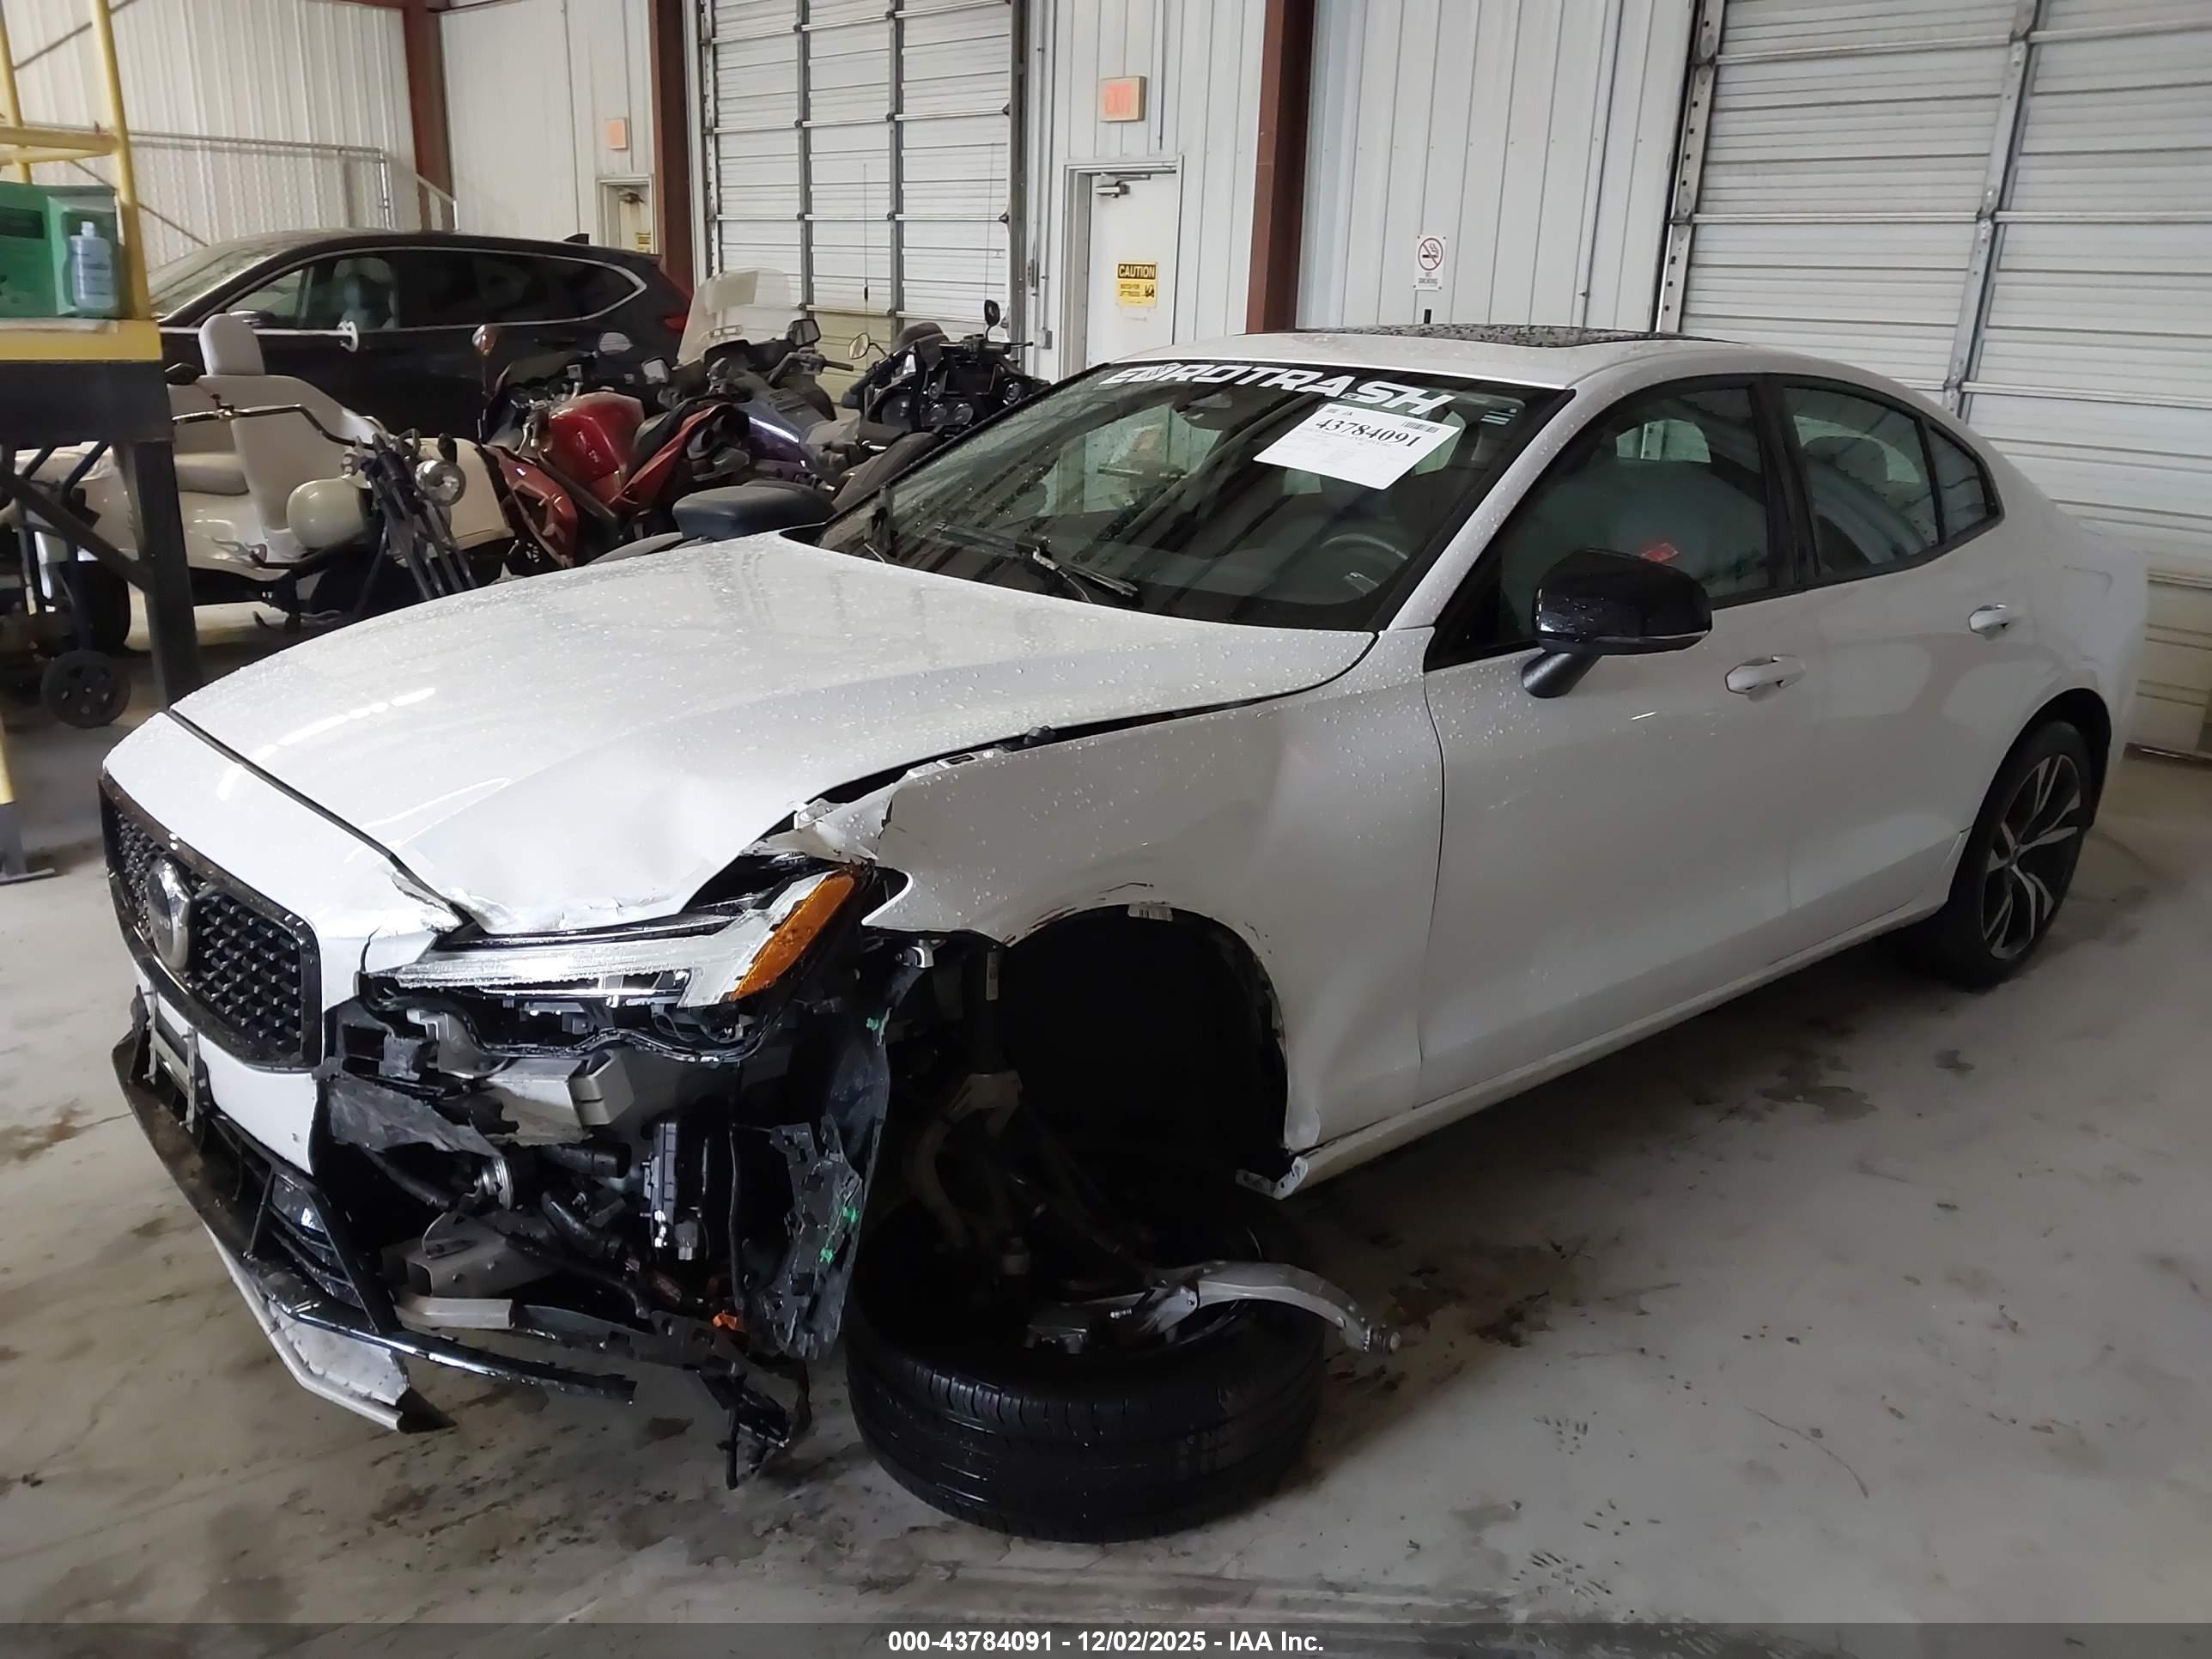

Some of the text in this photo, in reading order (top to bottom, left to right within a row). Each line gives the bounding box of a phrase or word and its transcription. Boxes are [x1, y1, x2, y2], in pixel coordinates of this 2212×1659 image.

[1119, 265, 1155, 278] CAUTION
[1099, 362, 1457, 416] EUROTRASH
[1316, 418, 1424, 447] 43784091
